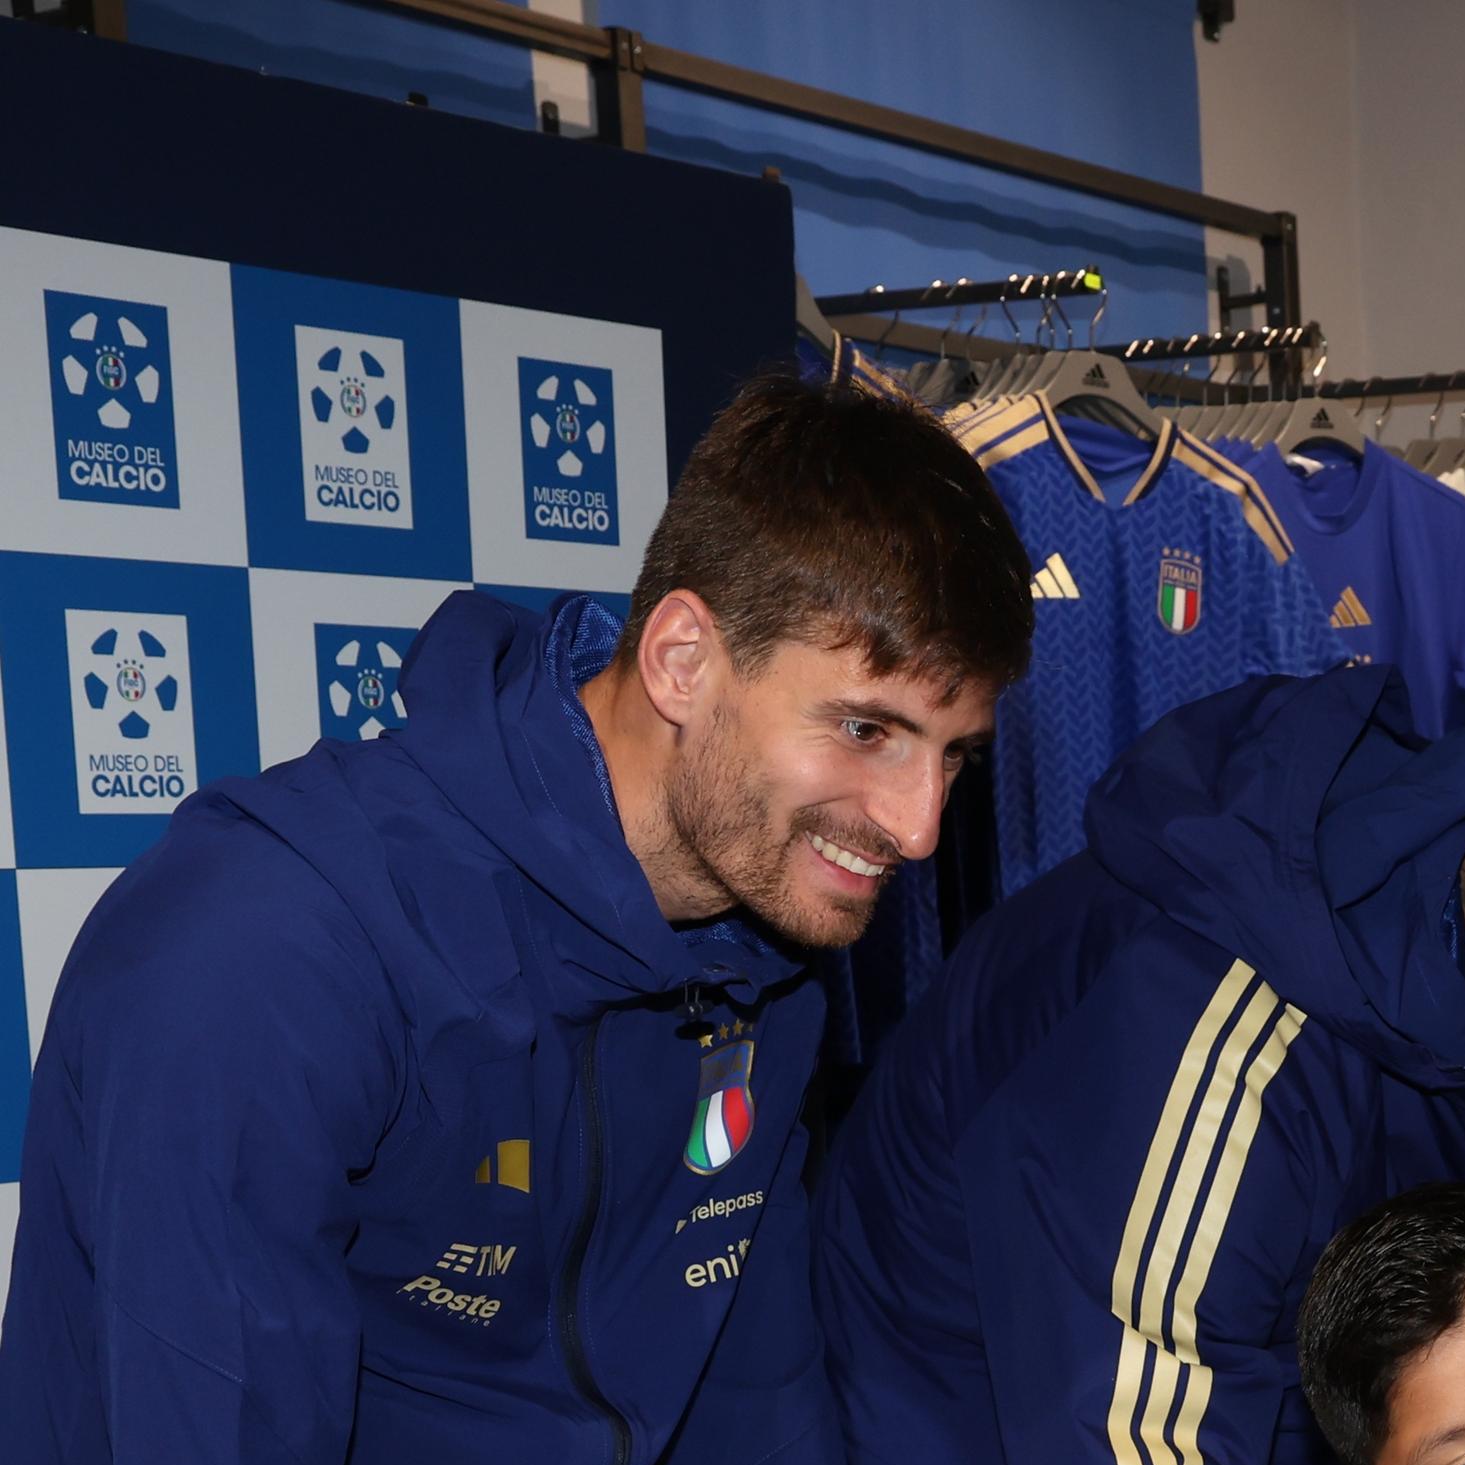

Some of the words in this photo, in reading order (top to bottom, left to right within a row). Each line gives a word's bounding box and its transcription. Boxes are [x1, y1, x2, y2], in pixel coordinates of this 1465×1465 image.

[67, 439, 129, 463] MUSEO
[134, 446, 165, 467] DEL
[69, 460, 166, 492] CALCIO
[314, 464, 368, 486] MUSEO
[373, 470, 399, 489] DEL
[316, 484, 400, 512] CALCIO
[533, 486, 581, 507] MUSEO
[584, 491, 609, 509] DEL
[534, 504, 610, 532] CALCIO
[89, 754, 149, 772] MUSEO
[154, 755, 184, 773] DEL
[91, 774, 185, 798] CALCIO
[689, 1190, 764, 1223] Telepass
[476, 1244, 517, 1276] TIM
[685, 1244, 739, 1287] eni
[402, 1275, 501, 1318] Poste
